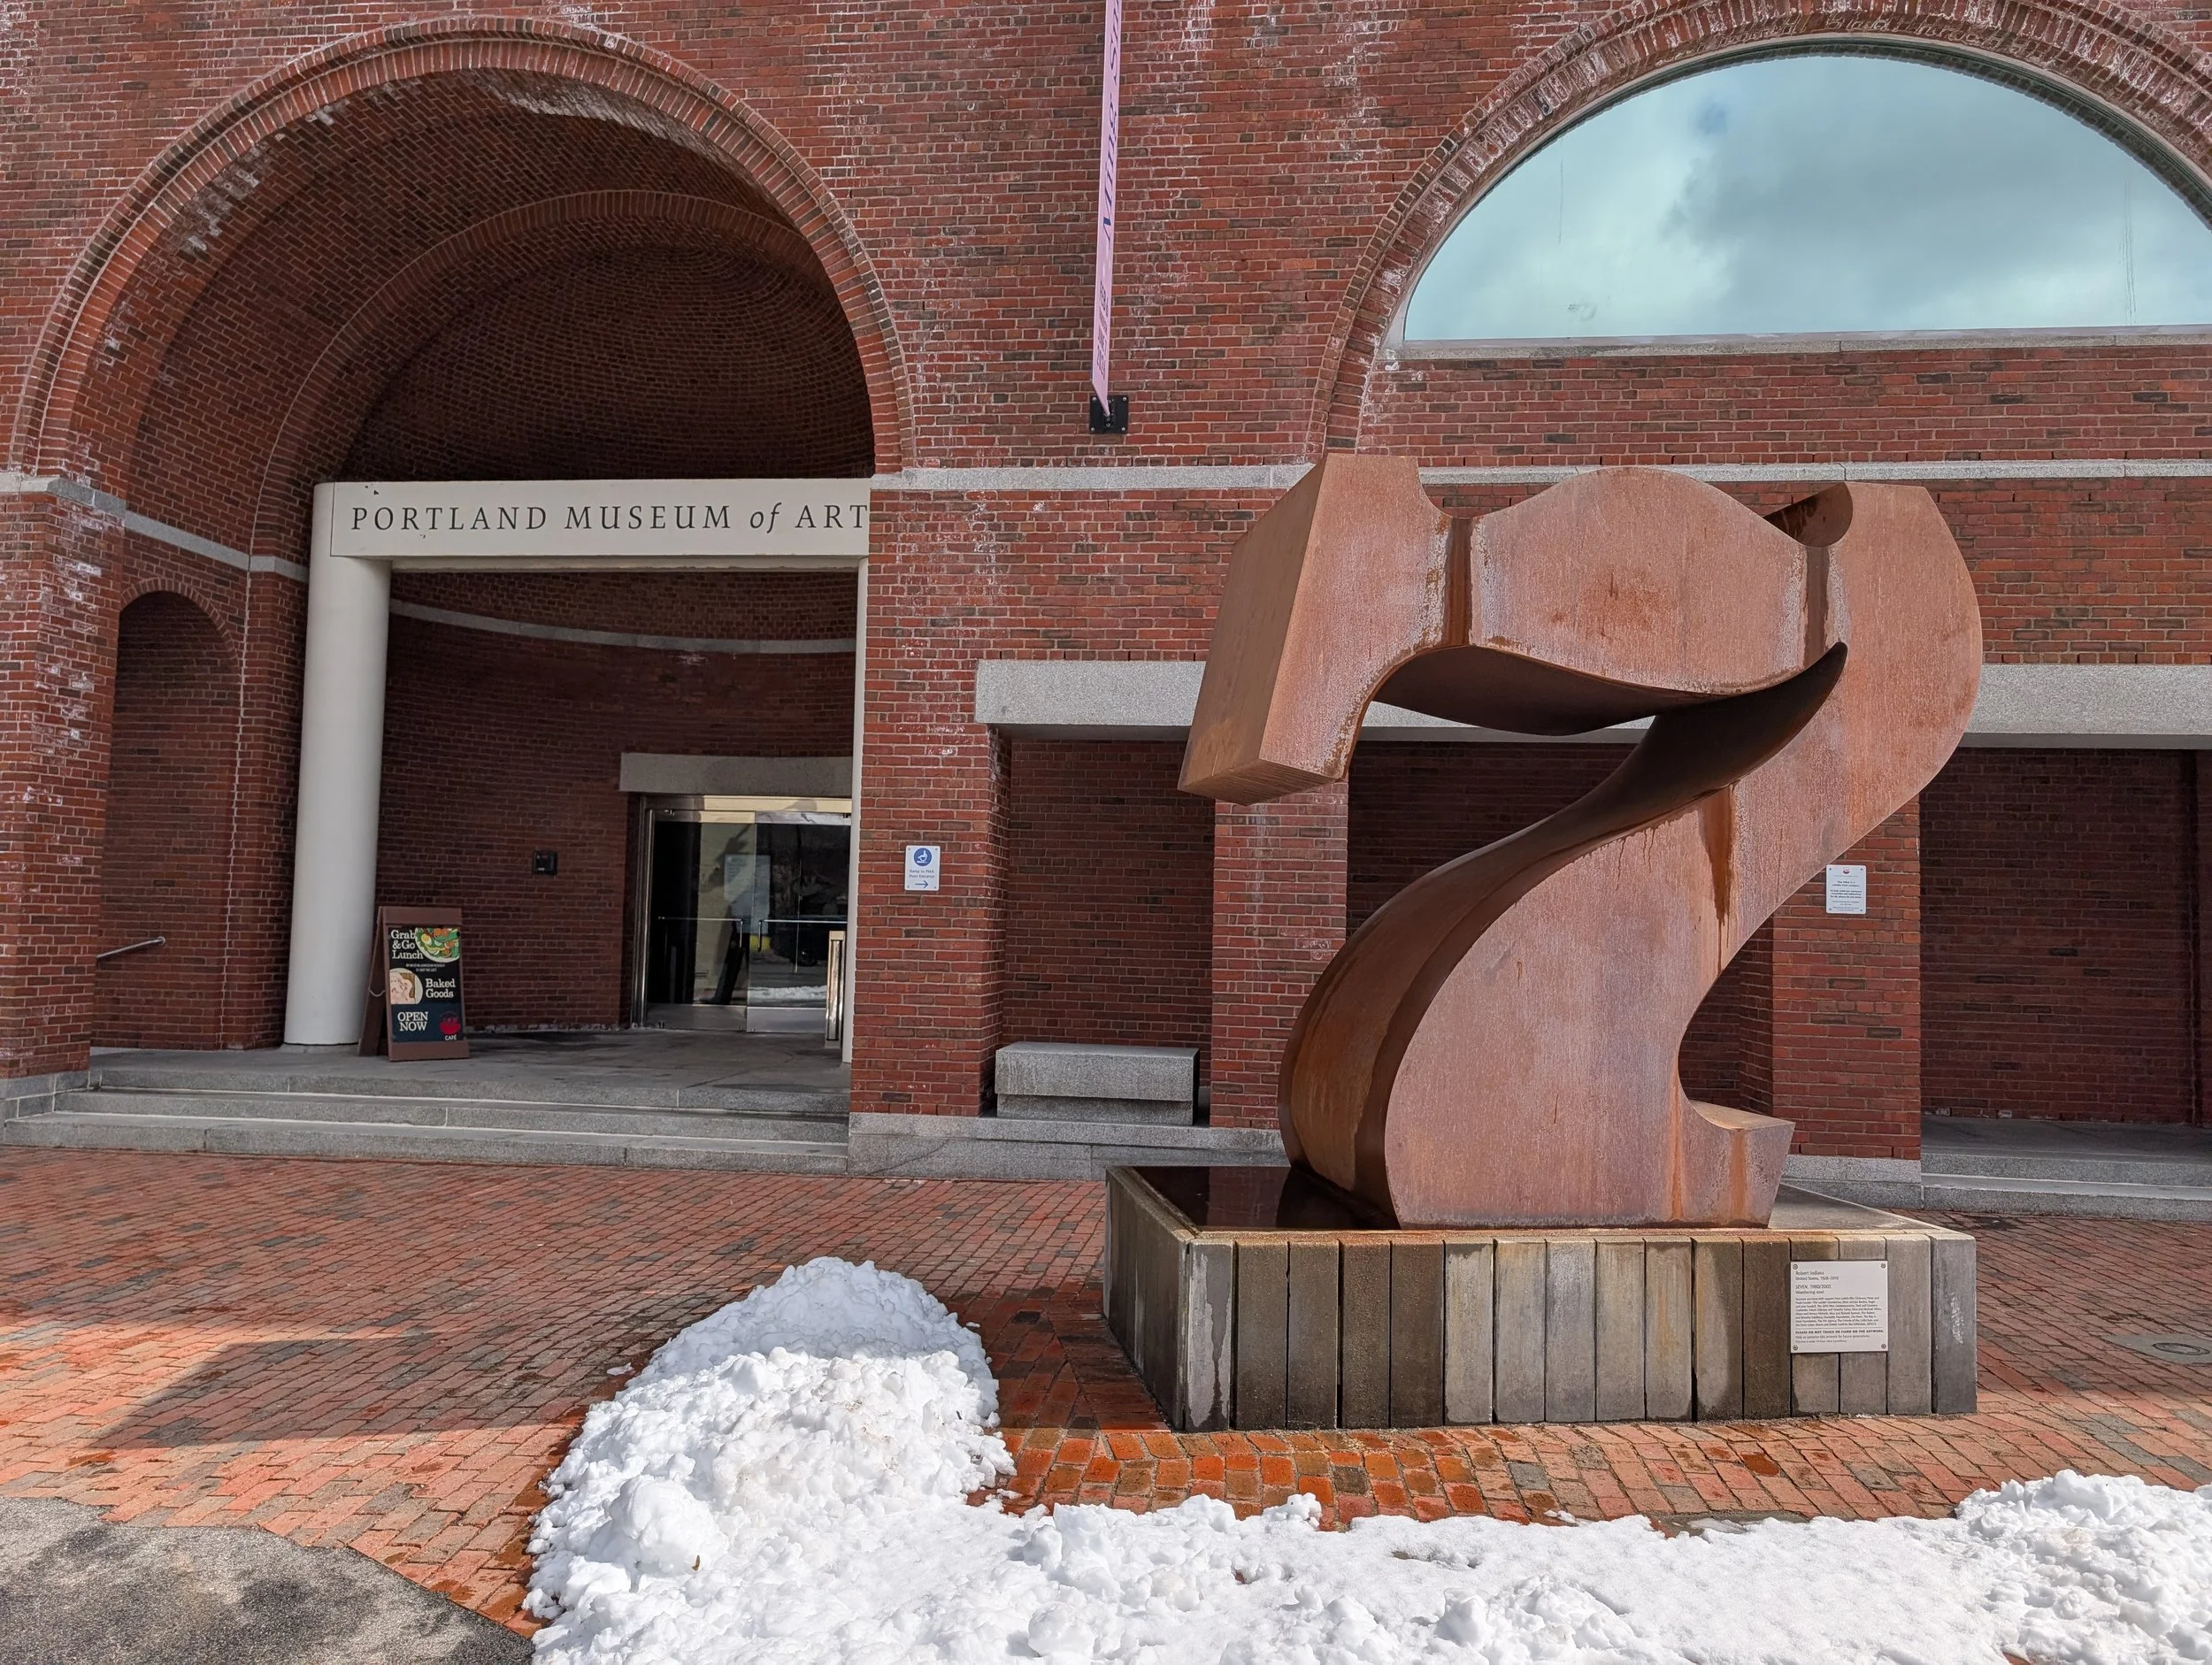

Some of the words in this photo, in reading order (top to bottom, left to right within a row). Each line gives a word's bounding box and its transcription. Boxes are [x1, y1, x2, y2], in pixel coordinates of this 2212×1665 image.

[350, 506, 547, 532] PORTLAND
[564, 504, 732, 531] MUSEUM
[749, 502, 782, 534] of
[795, 504, 868, 529] ART
[390, 929, 417, 940] Grab
[391, 949, 424, 960] Lunch
[425, 978, 456, 988] Baked
[425, 988, 454, 999] Goods
[397, 1011, 428, 1022] OPEN
[399, 1022, 427, 1032] NOW
